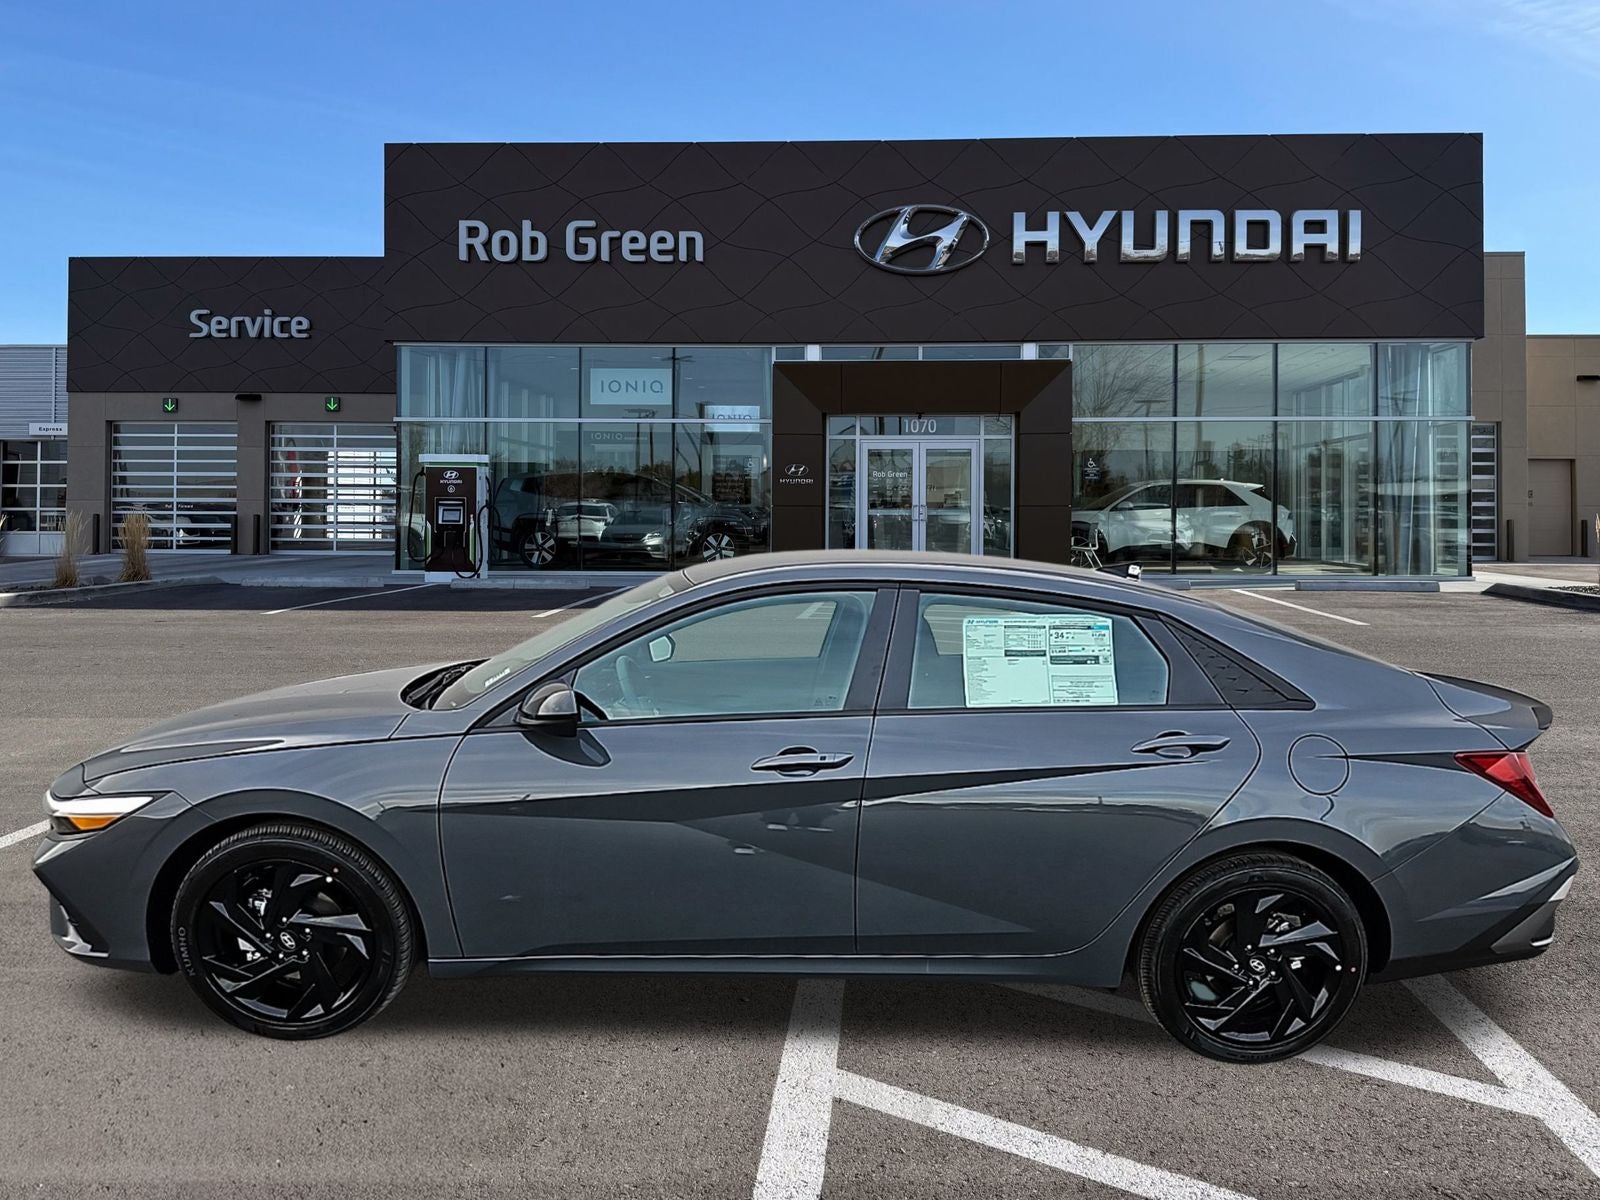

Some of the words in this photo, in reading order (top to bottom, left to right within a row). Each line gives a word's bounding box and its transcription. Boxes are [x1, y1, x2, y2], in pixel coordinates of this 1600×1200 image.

[457, 218, 549, 263] Rob
[565, 219, 705, 264] Green
[1012, 208, 1362, 264] HYUNDAI
[188, 308, 311, 339] Service
[600, 380, 664, 394] IONIQ
[903, 419, 937, 433] 1070
[591, 432, 624, 440] IONIQ
[872, 470, 886, 478] Rob
[887, 470, 908, 478] Green
[1054, 631, 1065, 640] 34
[178, 926, 196, 977] KUMHO
